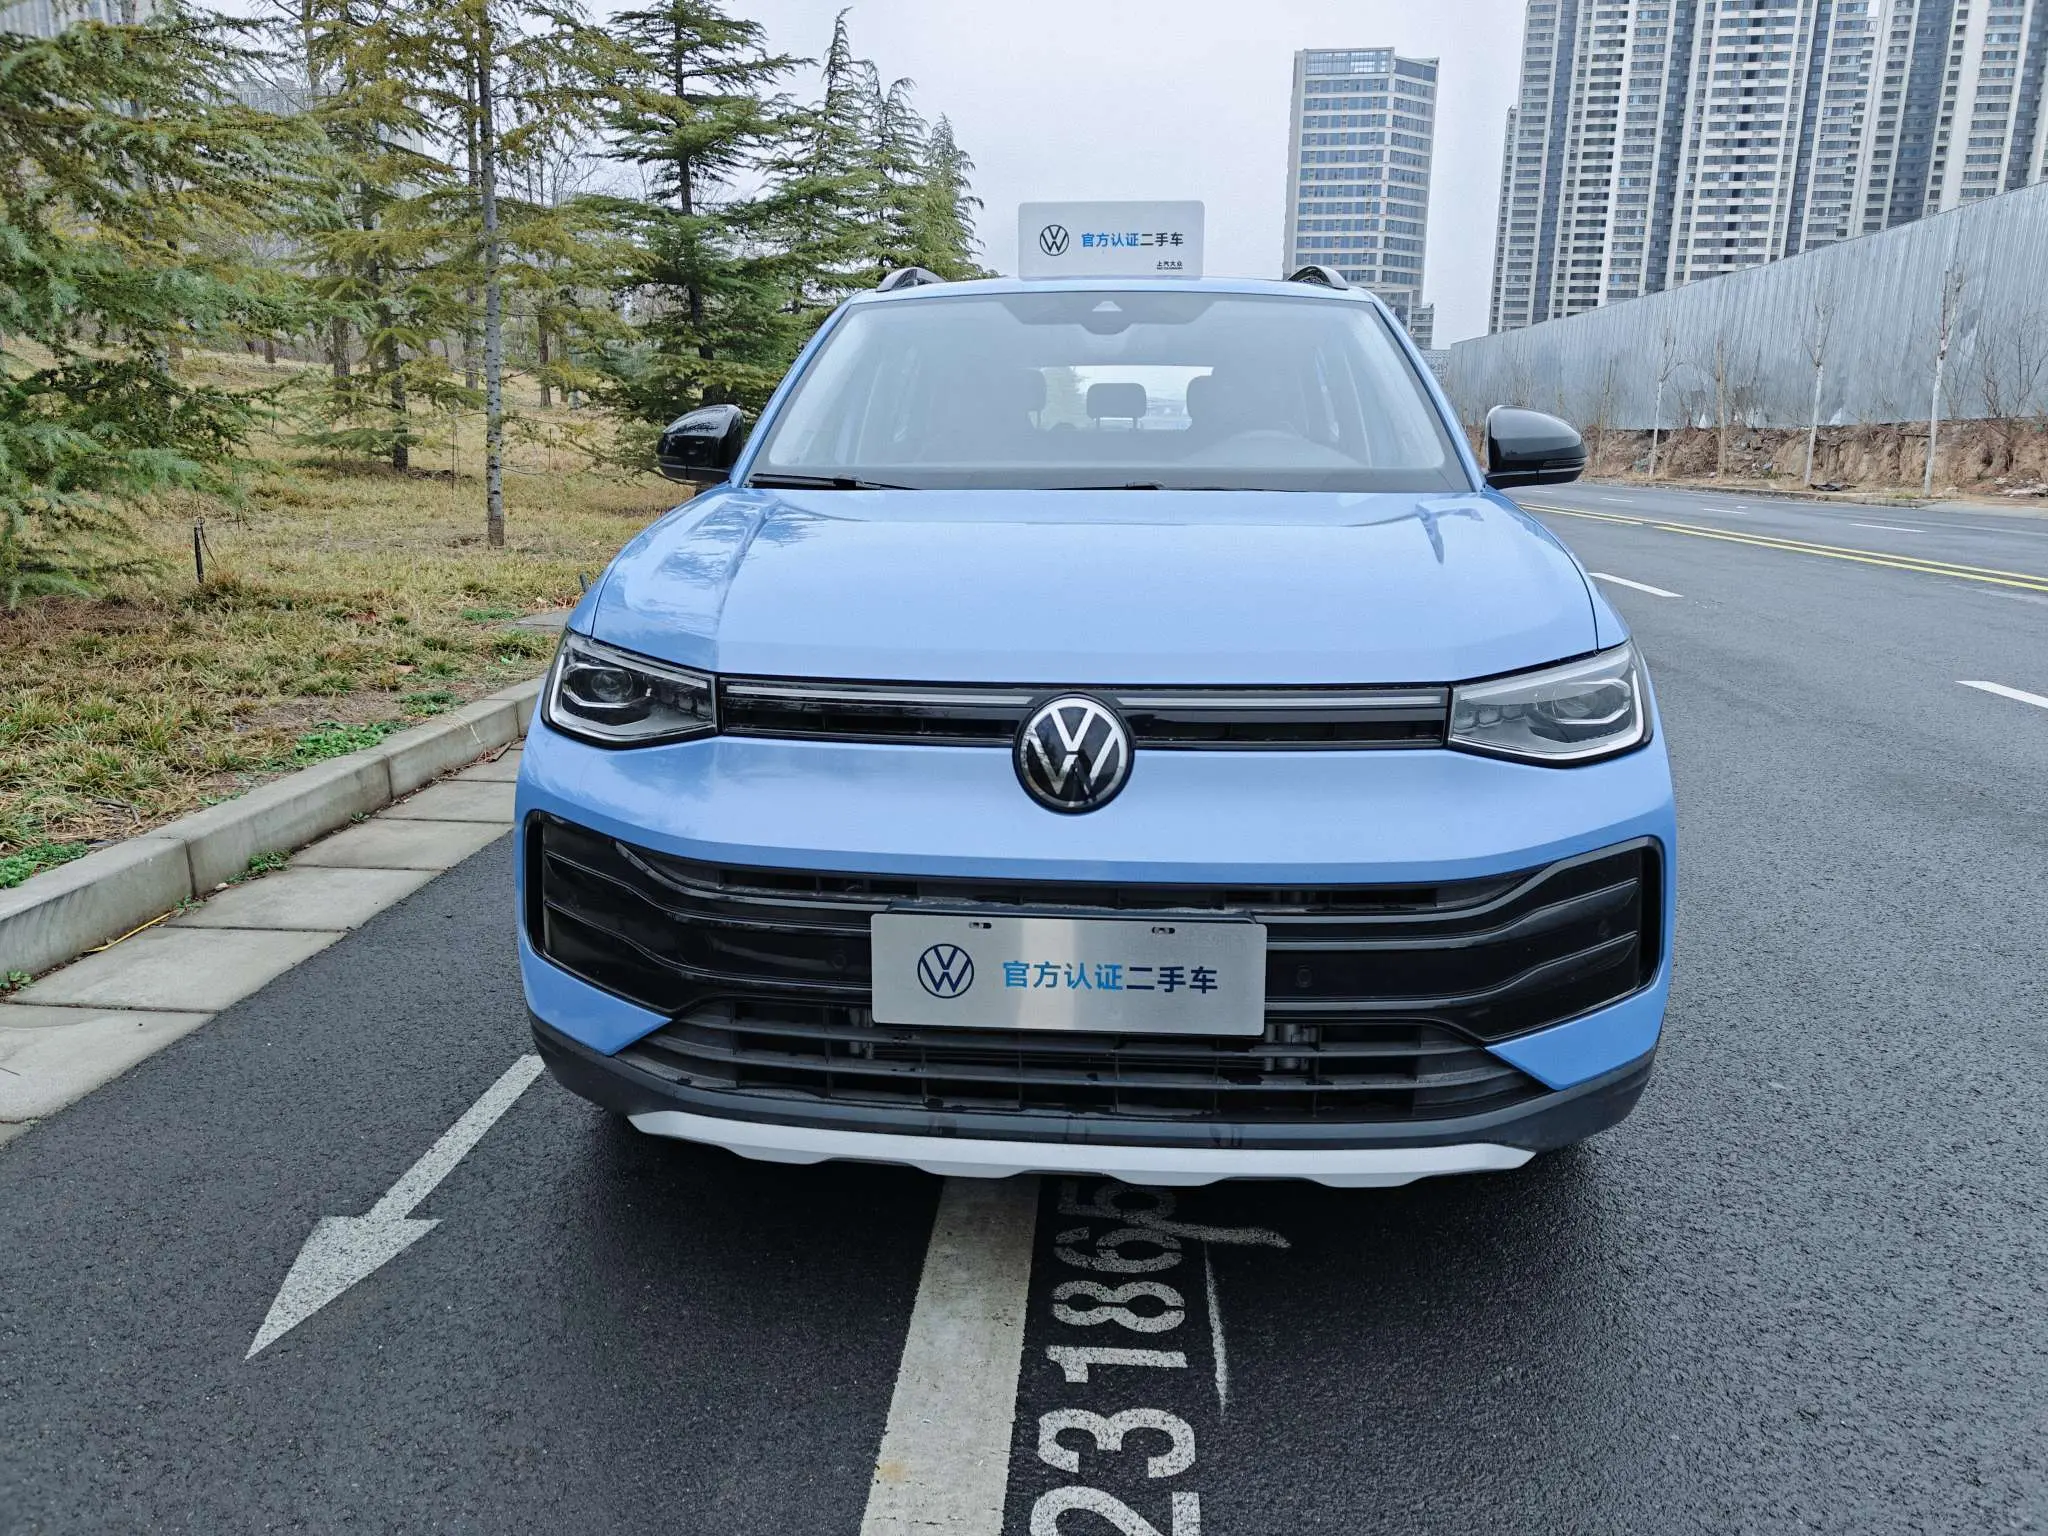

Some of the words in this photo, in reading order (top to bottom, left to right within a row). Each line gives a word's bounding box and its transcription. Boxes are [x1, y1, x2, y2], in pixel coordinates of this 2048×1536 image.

[1081, 232, 1184, 248] 官方认证二手车
[1002, 960, 1219, 994] 官方认证二手车
